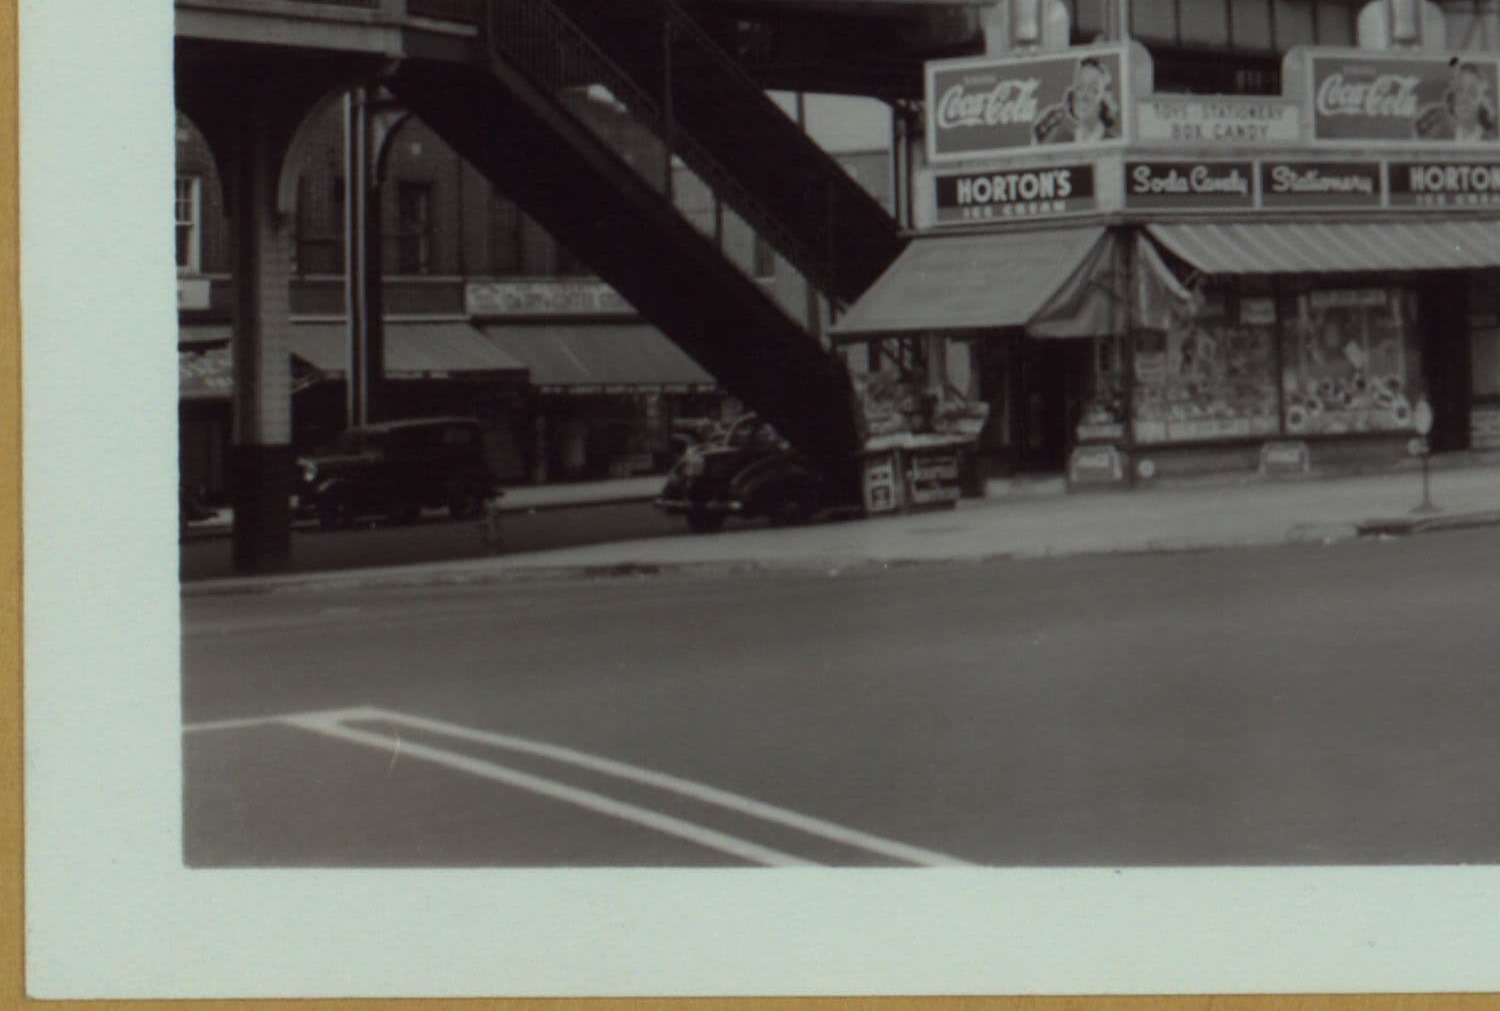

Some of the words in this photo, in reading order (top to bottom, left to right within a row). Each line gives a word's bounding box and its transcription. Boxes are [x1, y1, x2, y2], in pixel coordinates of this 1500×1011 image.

[938, 77, 1041, 129] Coca-Cola
[1317, 73, 1422, 116] Coca-Cola
[1172, 123, 1202, 140] BOX
[1214, 123, 1271, 140] CANDY
[957, 169, 1071, 205] HORTON'S
[1133, 165, 1189, 193] Soda
[1190, 165, 1248, 197] Candy
[1271, 165, 1373, 196] Stationery
[963, 205, 993, 219] ICE
[1002, 200, 1067, 217] CREAM
